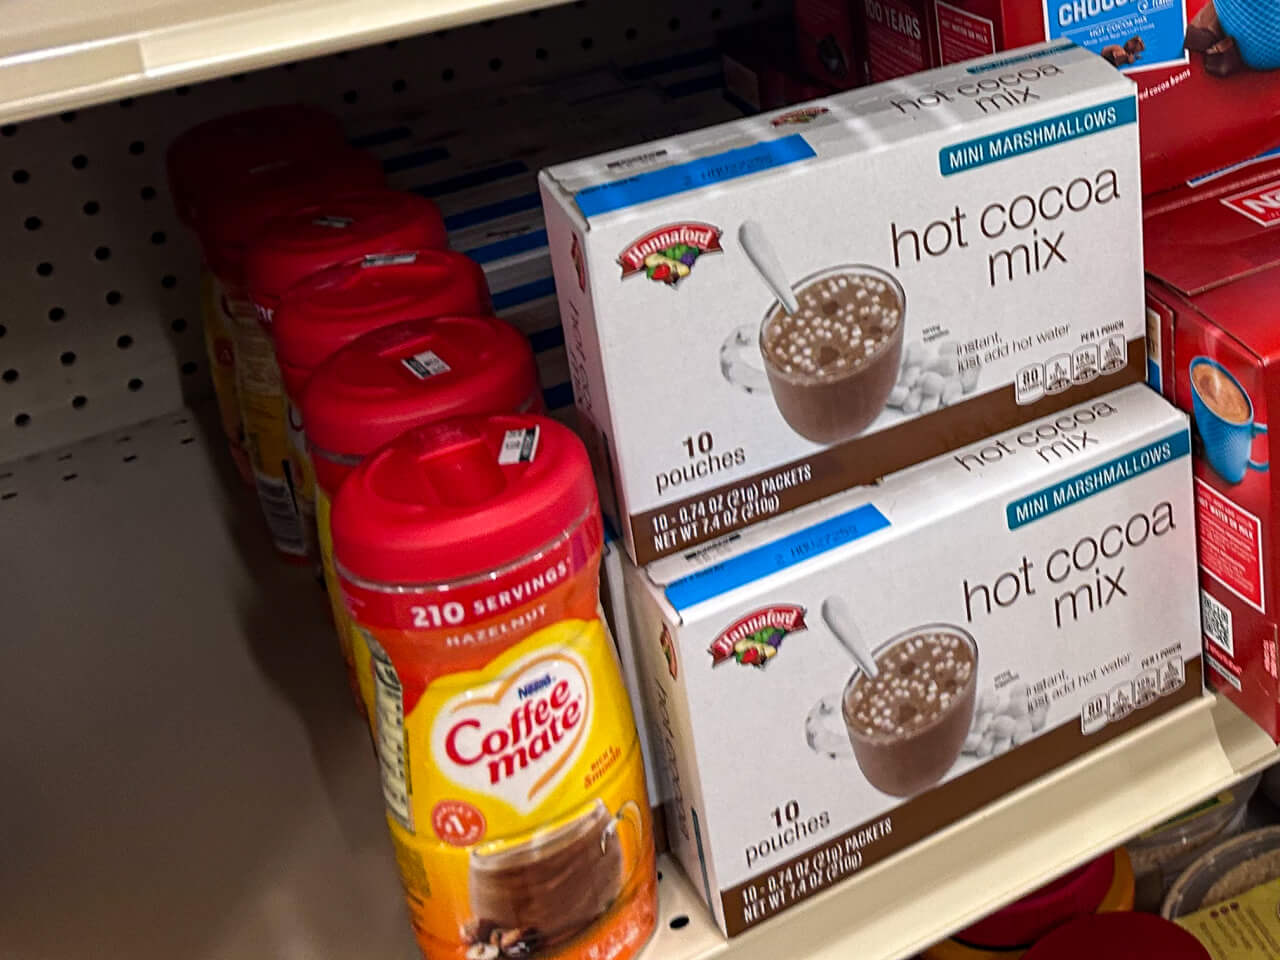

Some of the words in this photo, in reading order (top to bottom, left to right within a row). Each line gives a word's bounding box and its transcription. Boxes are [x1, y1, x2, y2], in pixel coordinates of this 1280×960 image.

[884, 5, 922, 40] YEARS
[890, 86, 955, 115] hot
[957, 61, 1065, 98] cocoa
[975, 83, 1041, 115] mix
[949, 147, 985, 170] MINI
[989, 106, 1118, 158] MARSHMALLOWS
[626, 224, 714, 266] Hannaford
[890, 205, 969, 269] hot
[980, 167, 1121, 239] cocoa
[988, 228, 1068, 287] mix
[957, 356, 981, 374] just
[984, 346, 1010, 364] add
[1012, 337, 1033, 355] hot
[1036, 321, 1072, 345] water
[682, 430, 714, 458] 10
[953, 439, 1017, 473] hot
[1016, 400, 1118, 449] cocoa
[1035, 429, 1099, 465] mix
[655, 445, 747, 495] pouches
[1015, 499, 1049, 523] MINI
[1052, 443, 1172, 507] MARSHMALLOWS
[653, 513, 668, 534] 10
[679, 501, 706, 523] 0.74
[708, 495, 723, 514] OZ
[761, 463, 812, 493] PACKETS
[654, 529, 678, 553] NET
[680, 522, 698, 541] WT
[702, 515, 721, 535] 7.4
[723, 508, 739, 528] OZ
[962, 556, 1036, 624] hot
[1046, 500, 1177, 584] cocoa
[410, 601, 465, 629] 210
[473, 566, 567, 615] SERVINGS
[1054, 566, 1128, 629] mix
[445, 604, 548, 648] HAZELNUT
[718, 608, 797, 653] Hannaford
[445, 679, 571, 767] Coffee
[487, 699, 582, 786] mate
[745, 810, 831, 869] pouches
[771, 800, 801, 829] 10
[742, 884, 757, 906] 10
[844, 816, 893, 854] PACKETS
[743, 898, 766, 925] NET
[767, 889, 785, 911] WT
